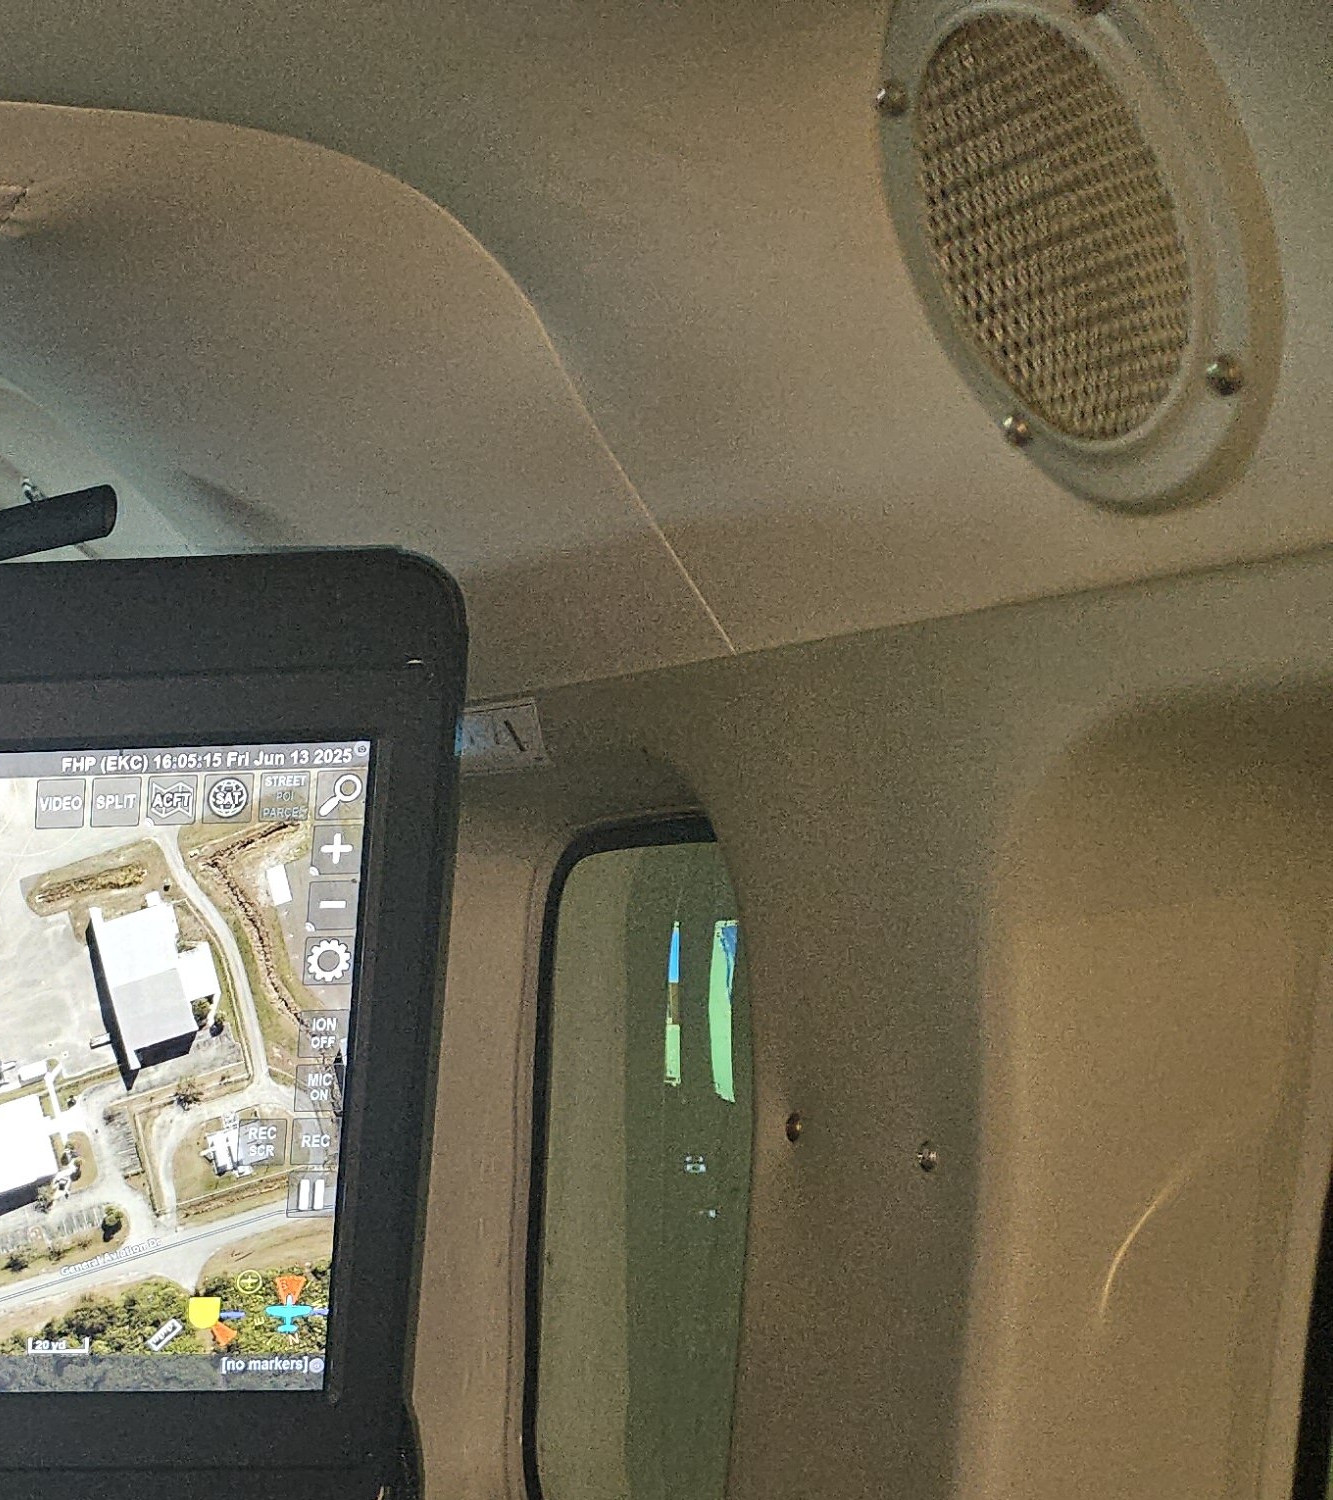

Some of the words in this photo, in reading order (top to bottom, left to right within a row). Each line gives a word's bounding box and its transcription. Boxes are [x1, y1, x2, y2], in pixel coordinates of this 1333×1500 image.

[61, 757, 96, 773] FHP
[100, 755, 148, 773] (EKC)
[153, 753, 222, 769] 16:05:15
[227, 752, 249, 767] Fri
[253, 751, 285, 766] Jun
[290, 750, 308, 765] 13
[313, 749, 352, 764] 2025
[264, 775, 306, 788] STREET
[40, 796, 82, 812] VIDEO
[95, 794, 136, 810] SPLIT
[152, 791, 191, 808] ACFT
[215, 791, 241, 806] SAT
[312, 1017, 337, 1032] ION
[311, 1036, 336, 1049] OFF
[308, 1073, 332, 1087] MIC
[310, 1089, 329, 1101] ON
[248, 1126, 277, 1140] REC
[301, 1134, 331, 1148] REC
[249, 1145, 275, 1157] SCR
[34, 1340, 49, 1351] 20
[52, 1339, 66, 1352] yd
[221, 1356, 245, 1374] [no
[248, 1356, 308, 1374] markers]
